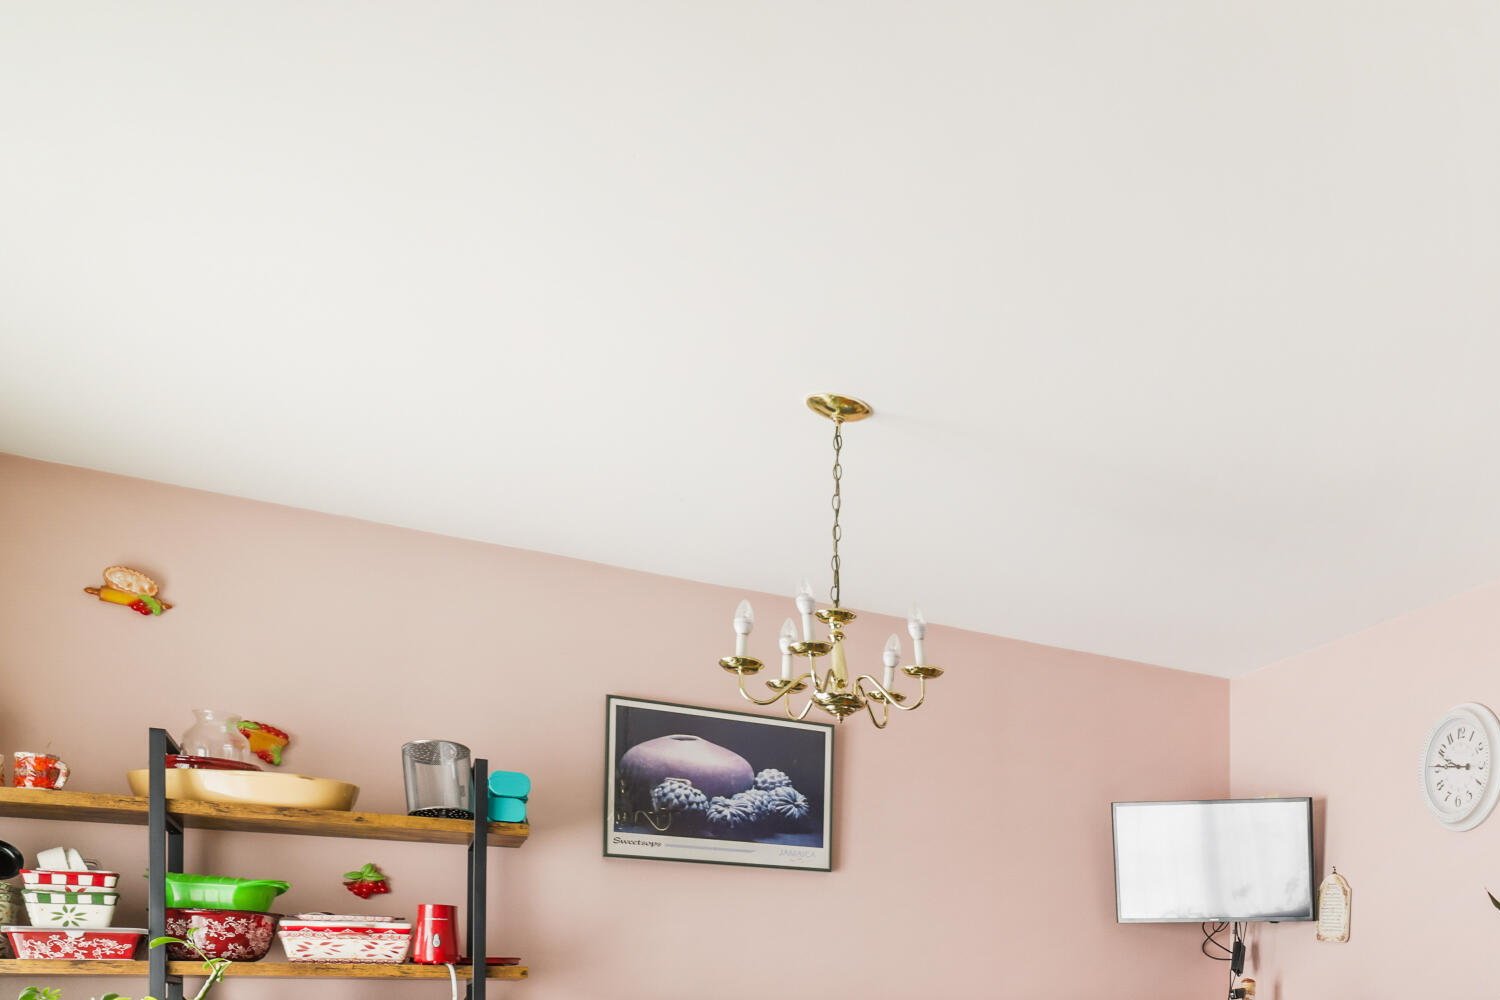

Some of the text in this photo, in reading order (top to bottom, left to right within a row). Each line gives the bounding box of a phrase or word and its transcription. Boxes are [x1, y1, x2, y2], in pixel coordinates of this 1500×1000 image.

[1446, 732, 1454, 745] 11
[1457, 727, 1466, 740] 12
[612, 835, 663, 848] Sweetsops
